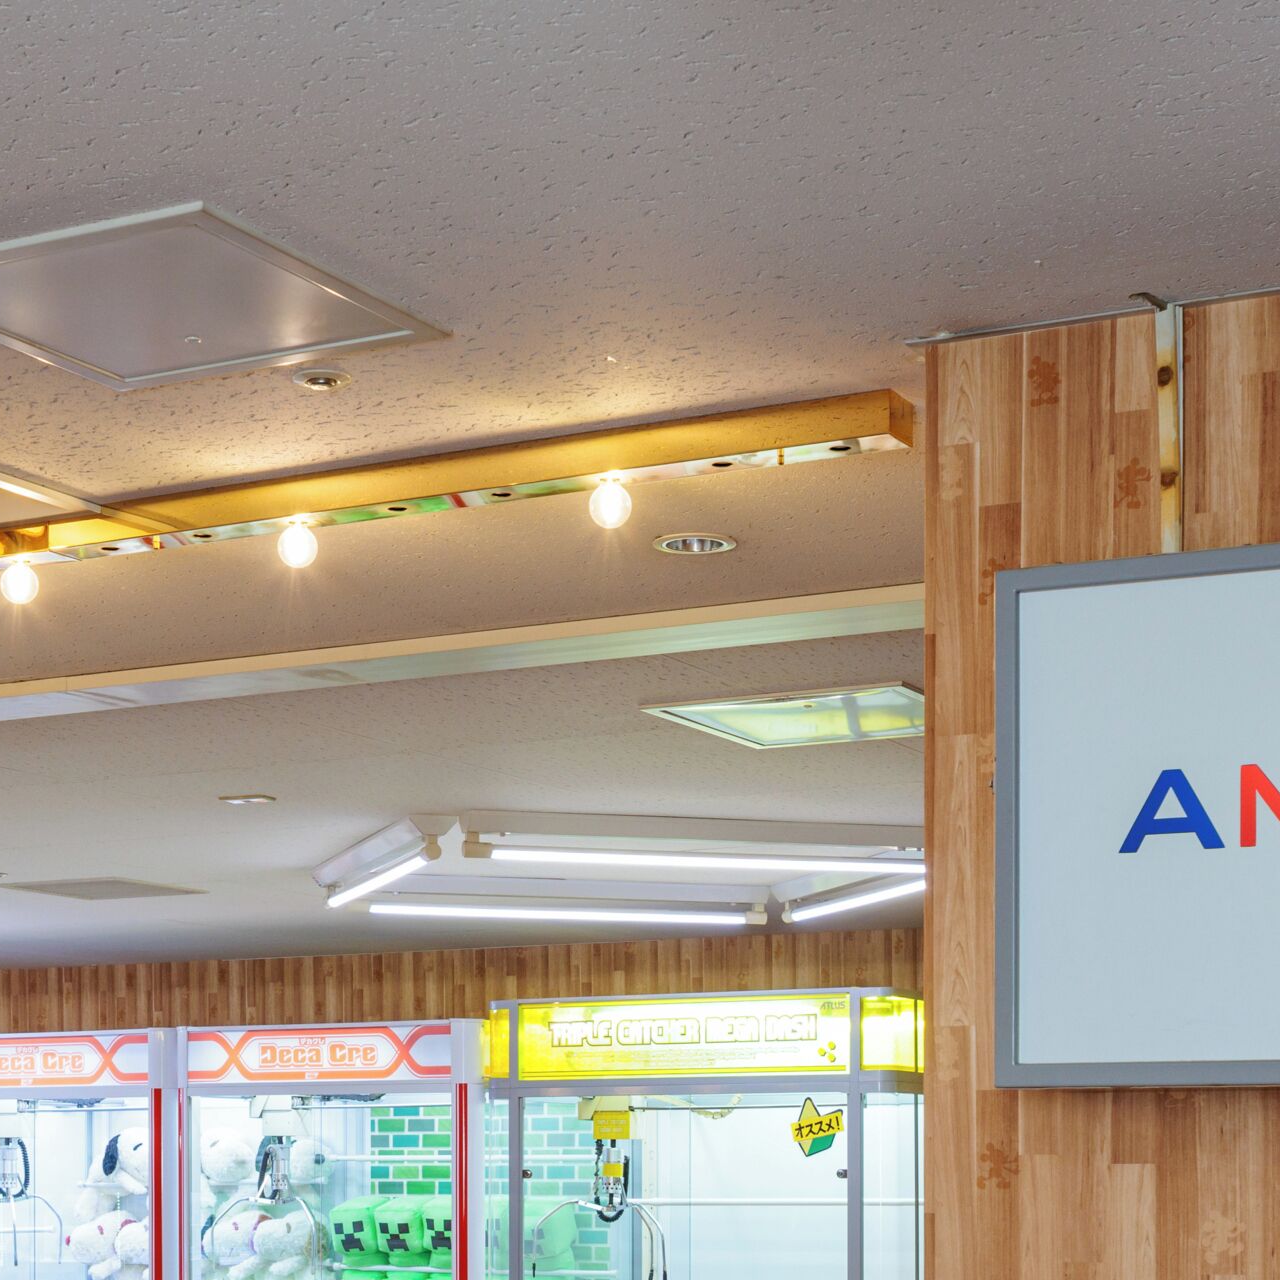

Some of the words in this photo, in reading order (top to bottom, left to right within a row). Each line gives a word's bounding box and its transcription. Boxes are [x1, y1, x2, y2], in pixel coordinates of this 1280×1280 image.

[548, 1020, 612, 1048] TRIPLE
[617, 1018, 701, 1046] CATCHER
[41, 1051, 84, 1071] Cre
[259, 1045, 322, 1065] Deca
[328, 1043, 377, 1064] Cre
[794, 1116, 840, 1138] オススメ!
